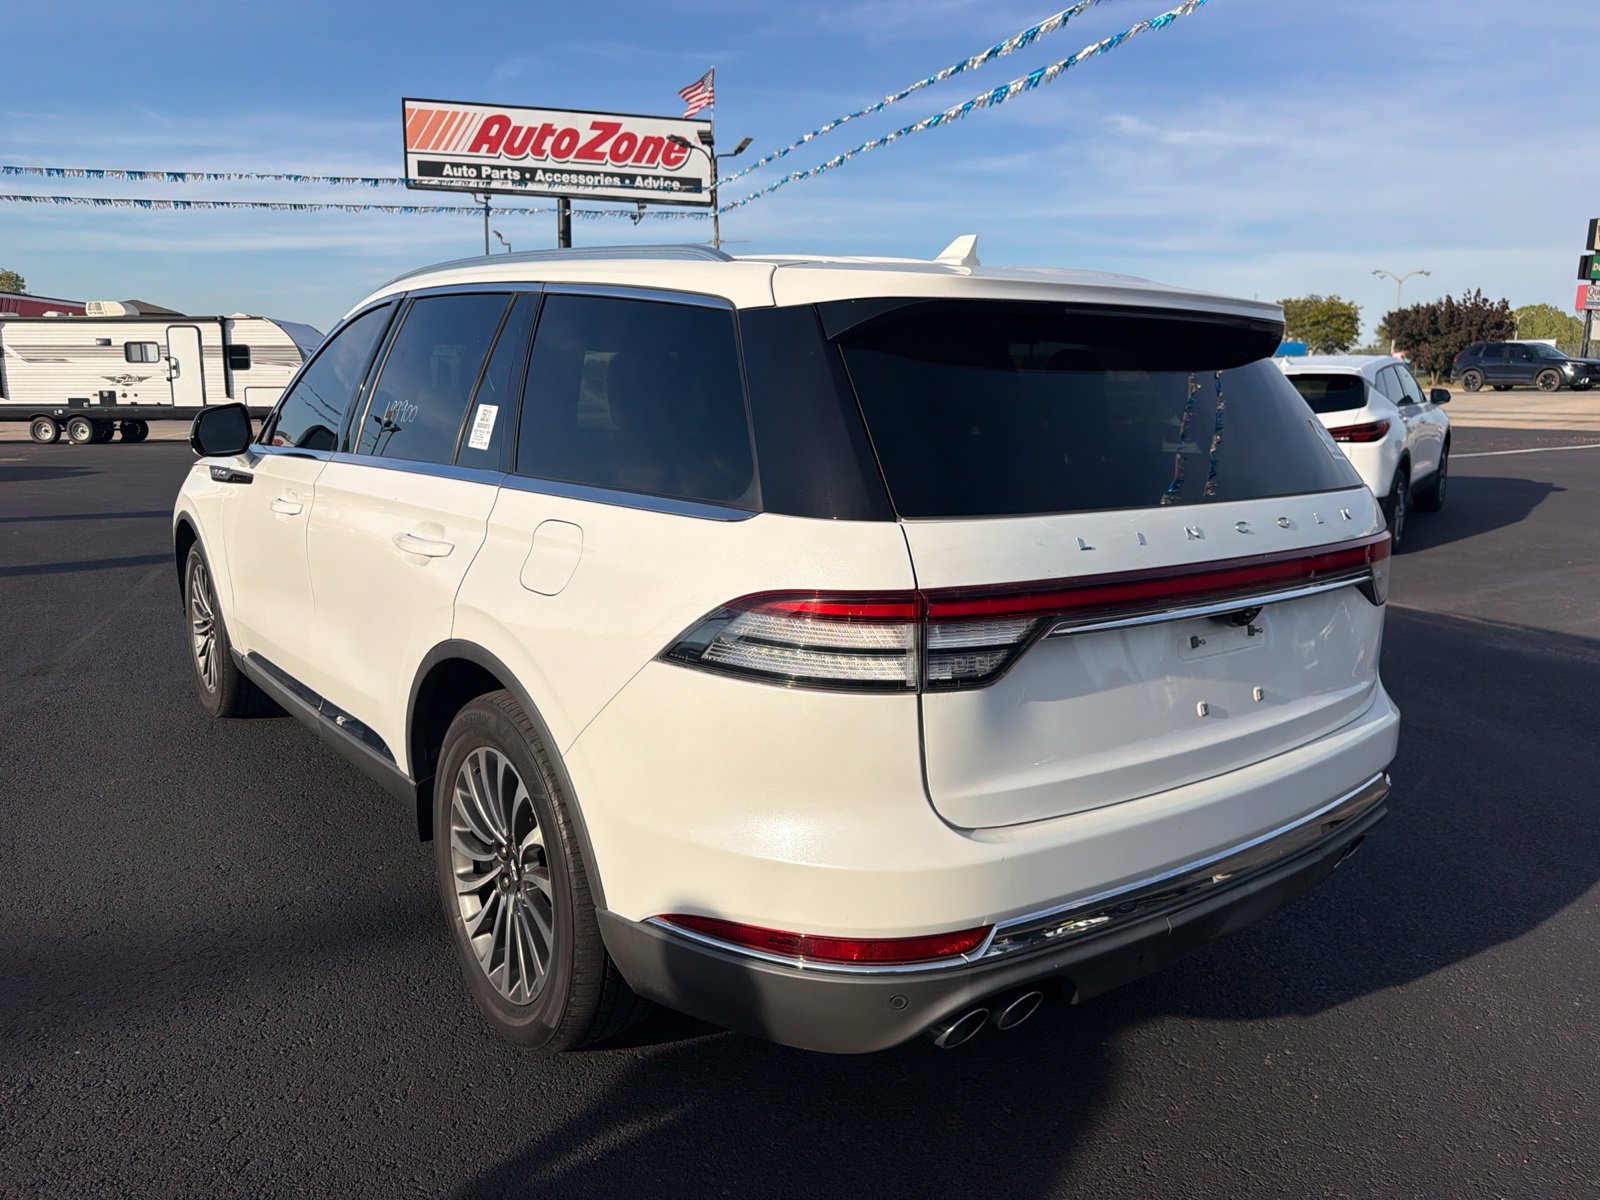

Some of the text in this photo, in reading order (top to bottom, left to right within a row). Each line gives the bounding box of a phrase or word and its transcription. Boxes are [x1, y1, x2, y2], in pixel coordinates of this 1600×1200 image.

[467, 113, 690, 169] AutoZone
[442, 163, 681, 191] Auto Parts Accessories Advice
[1075, 508, 1352, 551] LINCOLN
